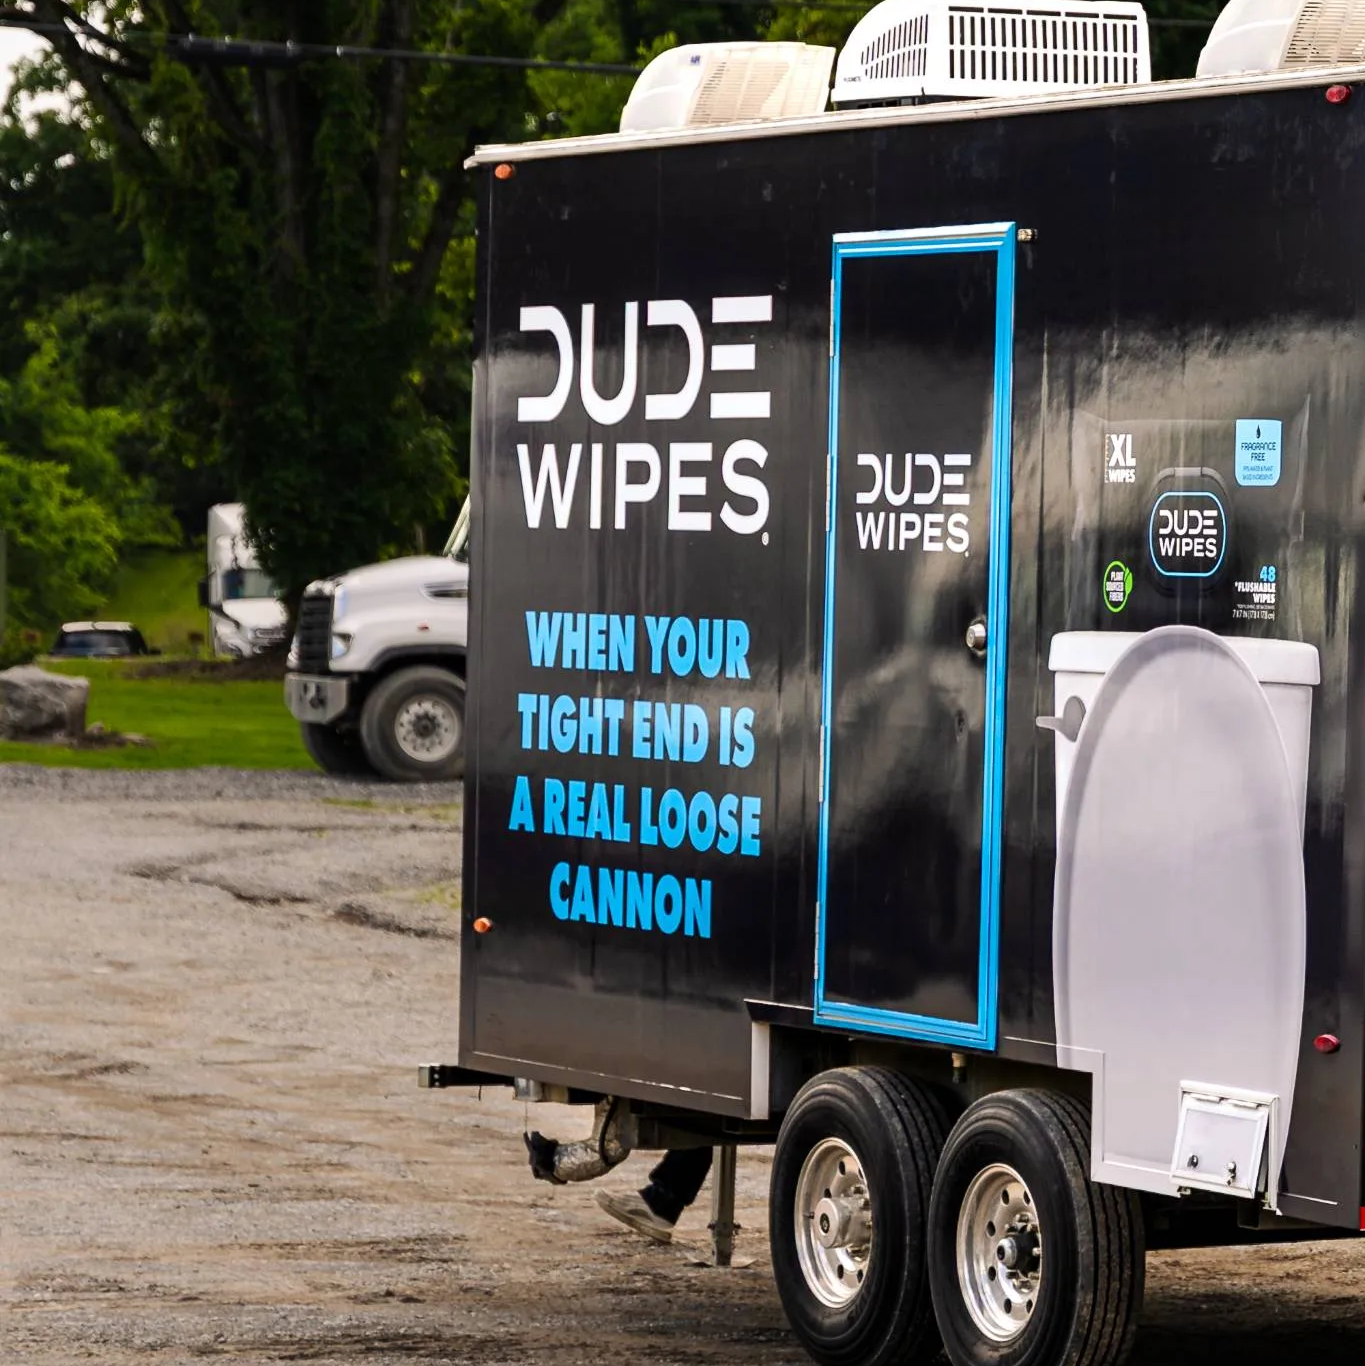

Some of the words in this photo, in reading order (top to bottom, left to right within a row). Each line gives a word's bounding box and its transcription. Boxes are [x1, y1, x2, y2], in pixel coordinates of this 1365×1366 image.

[517, 295, 773, 426] DUDE
[1109, 434, 1136, 467] XL
[1241, 441, 1276, 451] FRAGRANCE
[1251, 452, 1265, 461] FREE
[856, 452, 971, 506] DUDE
[1108, 468, 1136, 484] WIPES
[855, 511, 970, 554] WIPES
[1158, 509, 1218, 536] DUDE
[1158, 537, 1218, 558] WIPES
[1260, 565, 1276, 582] 48
[1252, 593, 1276, 604] WIPES
[525, 610, 636, 673] WHEN
[645, 615, 750, 679] YOUR
[517, 692, 625, 757] TIGHT
[632, 699, 709, 763] END
[718, 709, 756, 768] IS
[508, 775, 535, 833] A
[543, 777, 631, 843] REAL
[639, 786, 761, 857] LOOSE
[549, 861, 712, 939] CANNON
